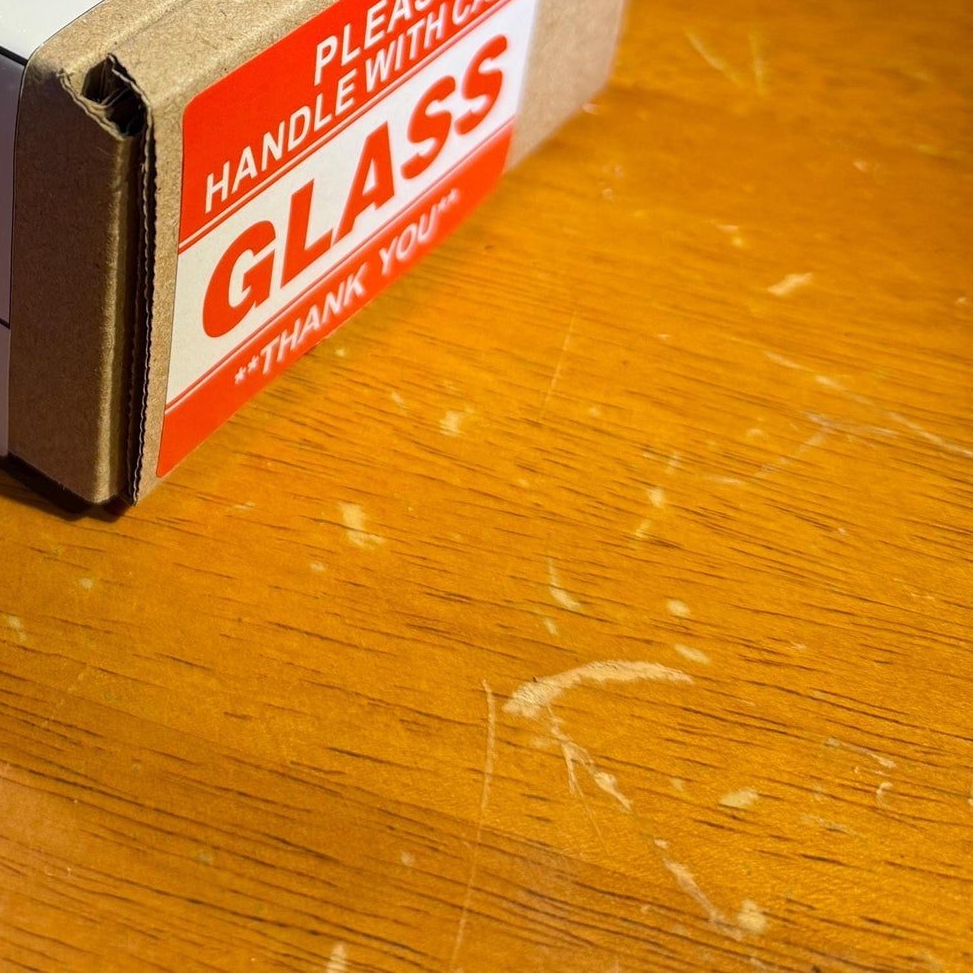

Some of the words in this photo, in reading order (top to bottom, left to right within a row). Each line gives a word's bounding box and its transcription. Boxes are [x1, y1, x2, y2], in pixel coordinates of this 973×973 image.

[202, 33, 509, 340] GLASS
[205, 71, 356, 214] HANDLE
[365, 2, 444, 92] WITH
